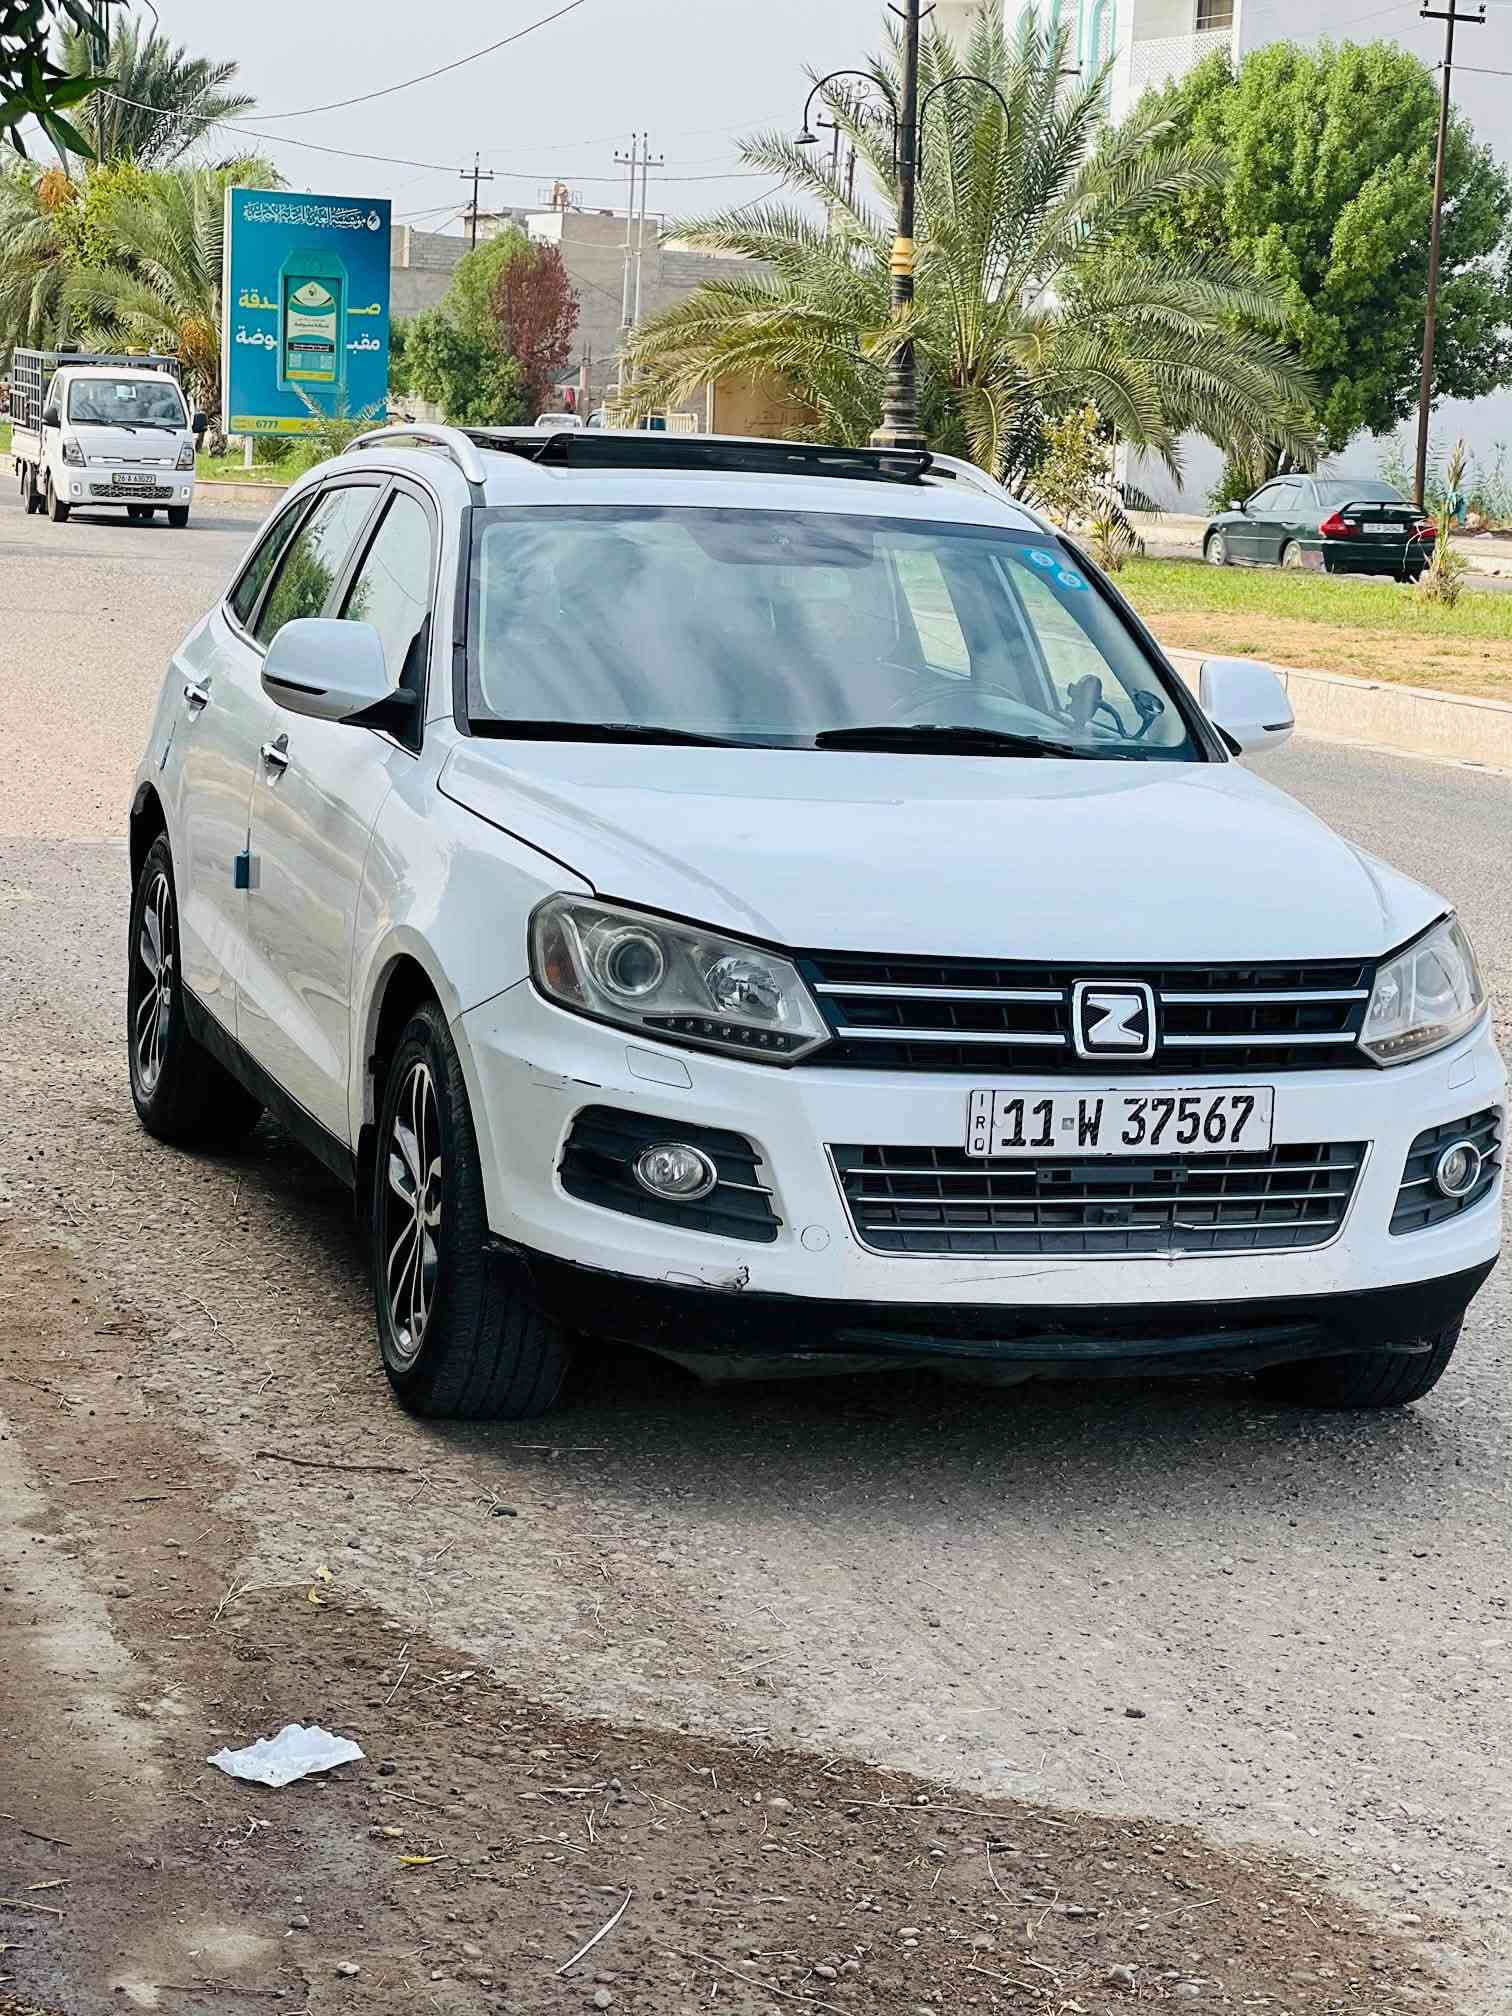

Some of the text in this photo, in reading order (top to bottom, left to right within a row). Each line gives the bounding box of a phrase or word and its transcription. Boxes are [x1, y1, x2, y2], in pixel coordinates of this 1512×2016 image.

[1001, 1095, 1256, 1147] 11 W 37567
